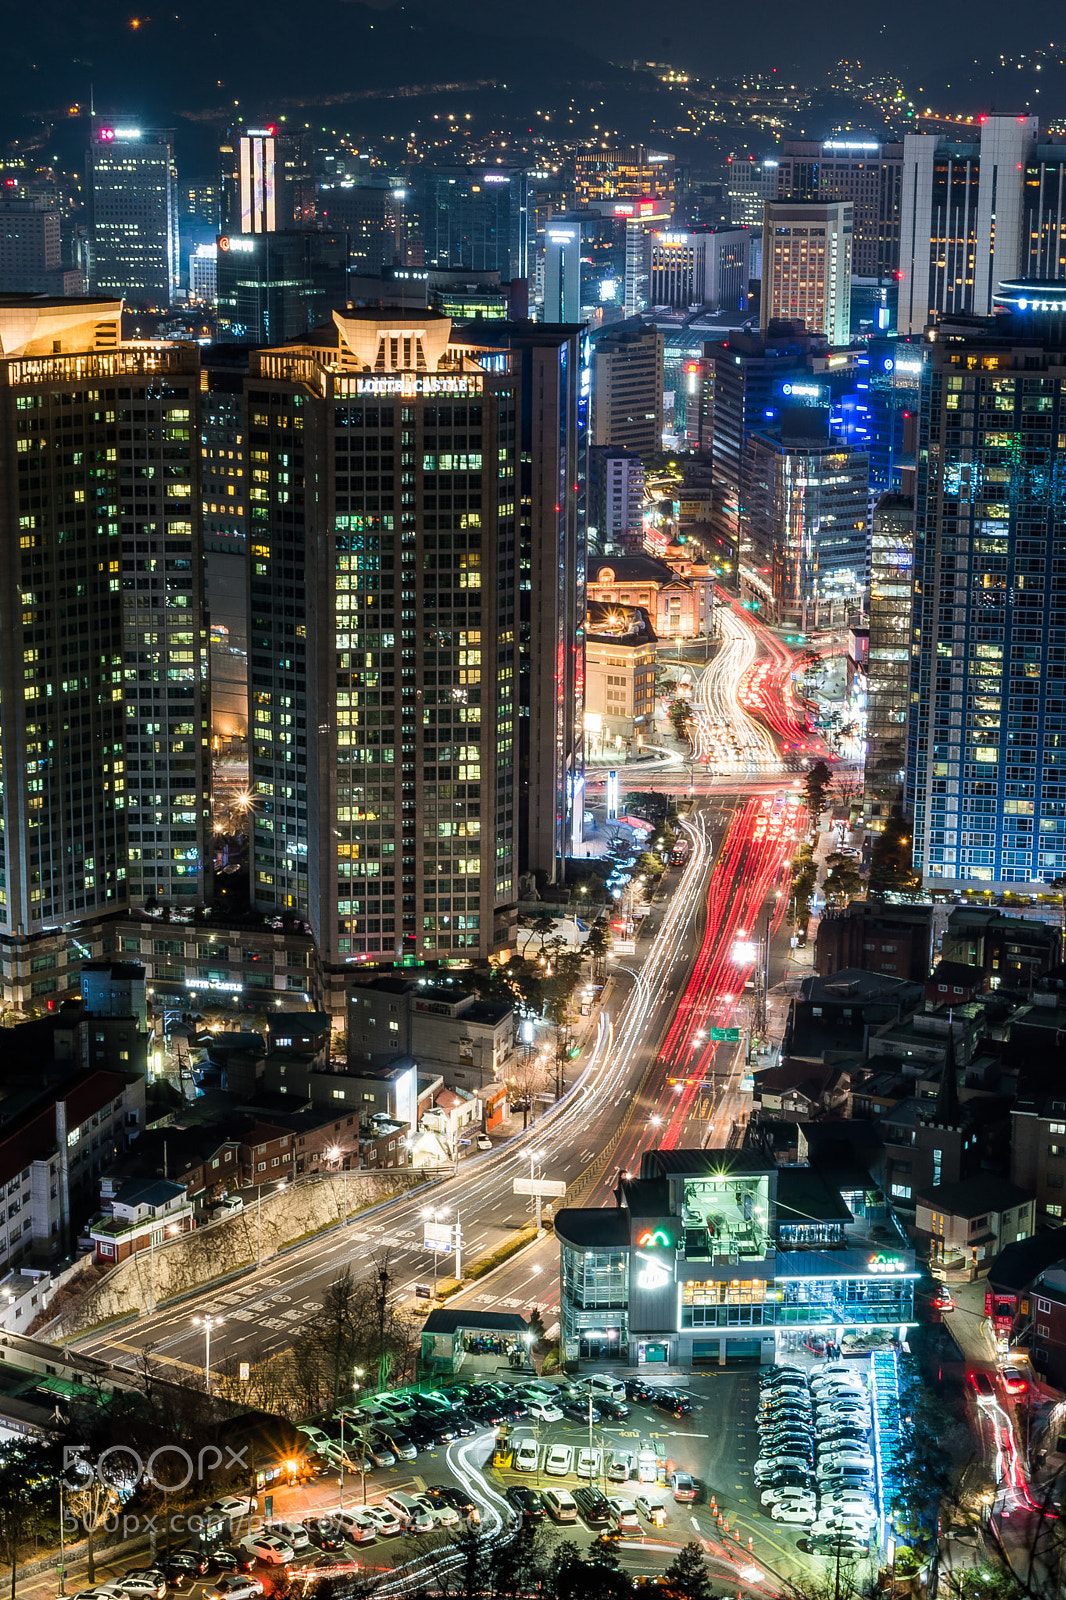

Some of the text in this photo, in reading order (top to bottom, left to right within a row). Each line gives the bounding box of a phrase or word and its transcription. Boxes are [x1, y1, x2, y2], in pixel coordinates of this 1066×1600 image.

[357, 379, 468, 392] LOTTE CASTLE
[185, 979, 243, 991] LOTTE CASTLE
